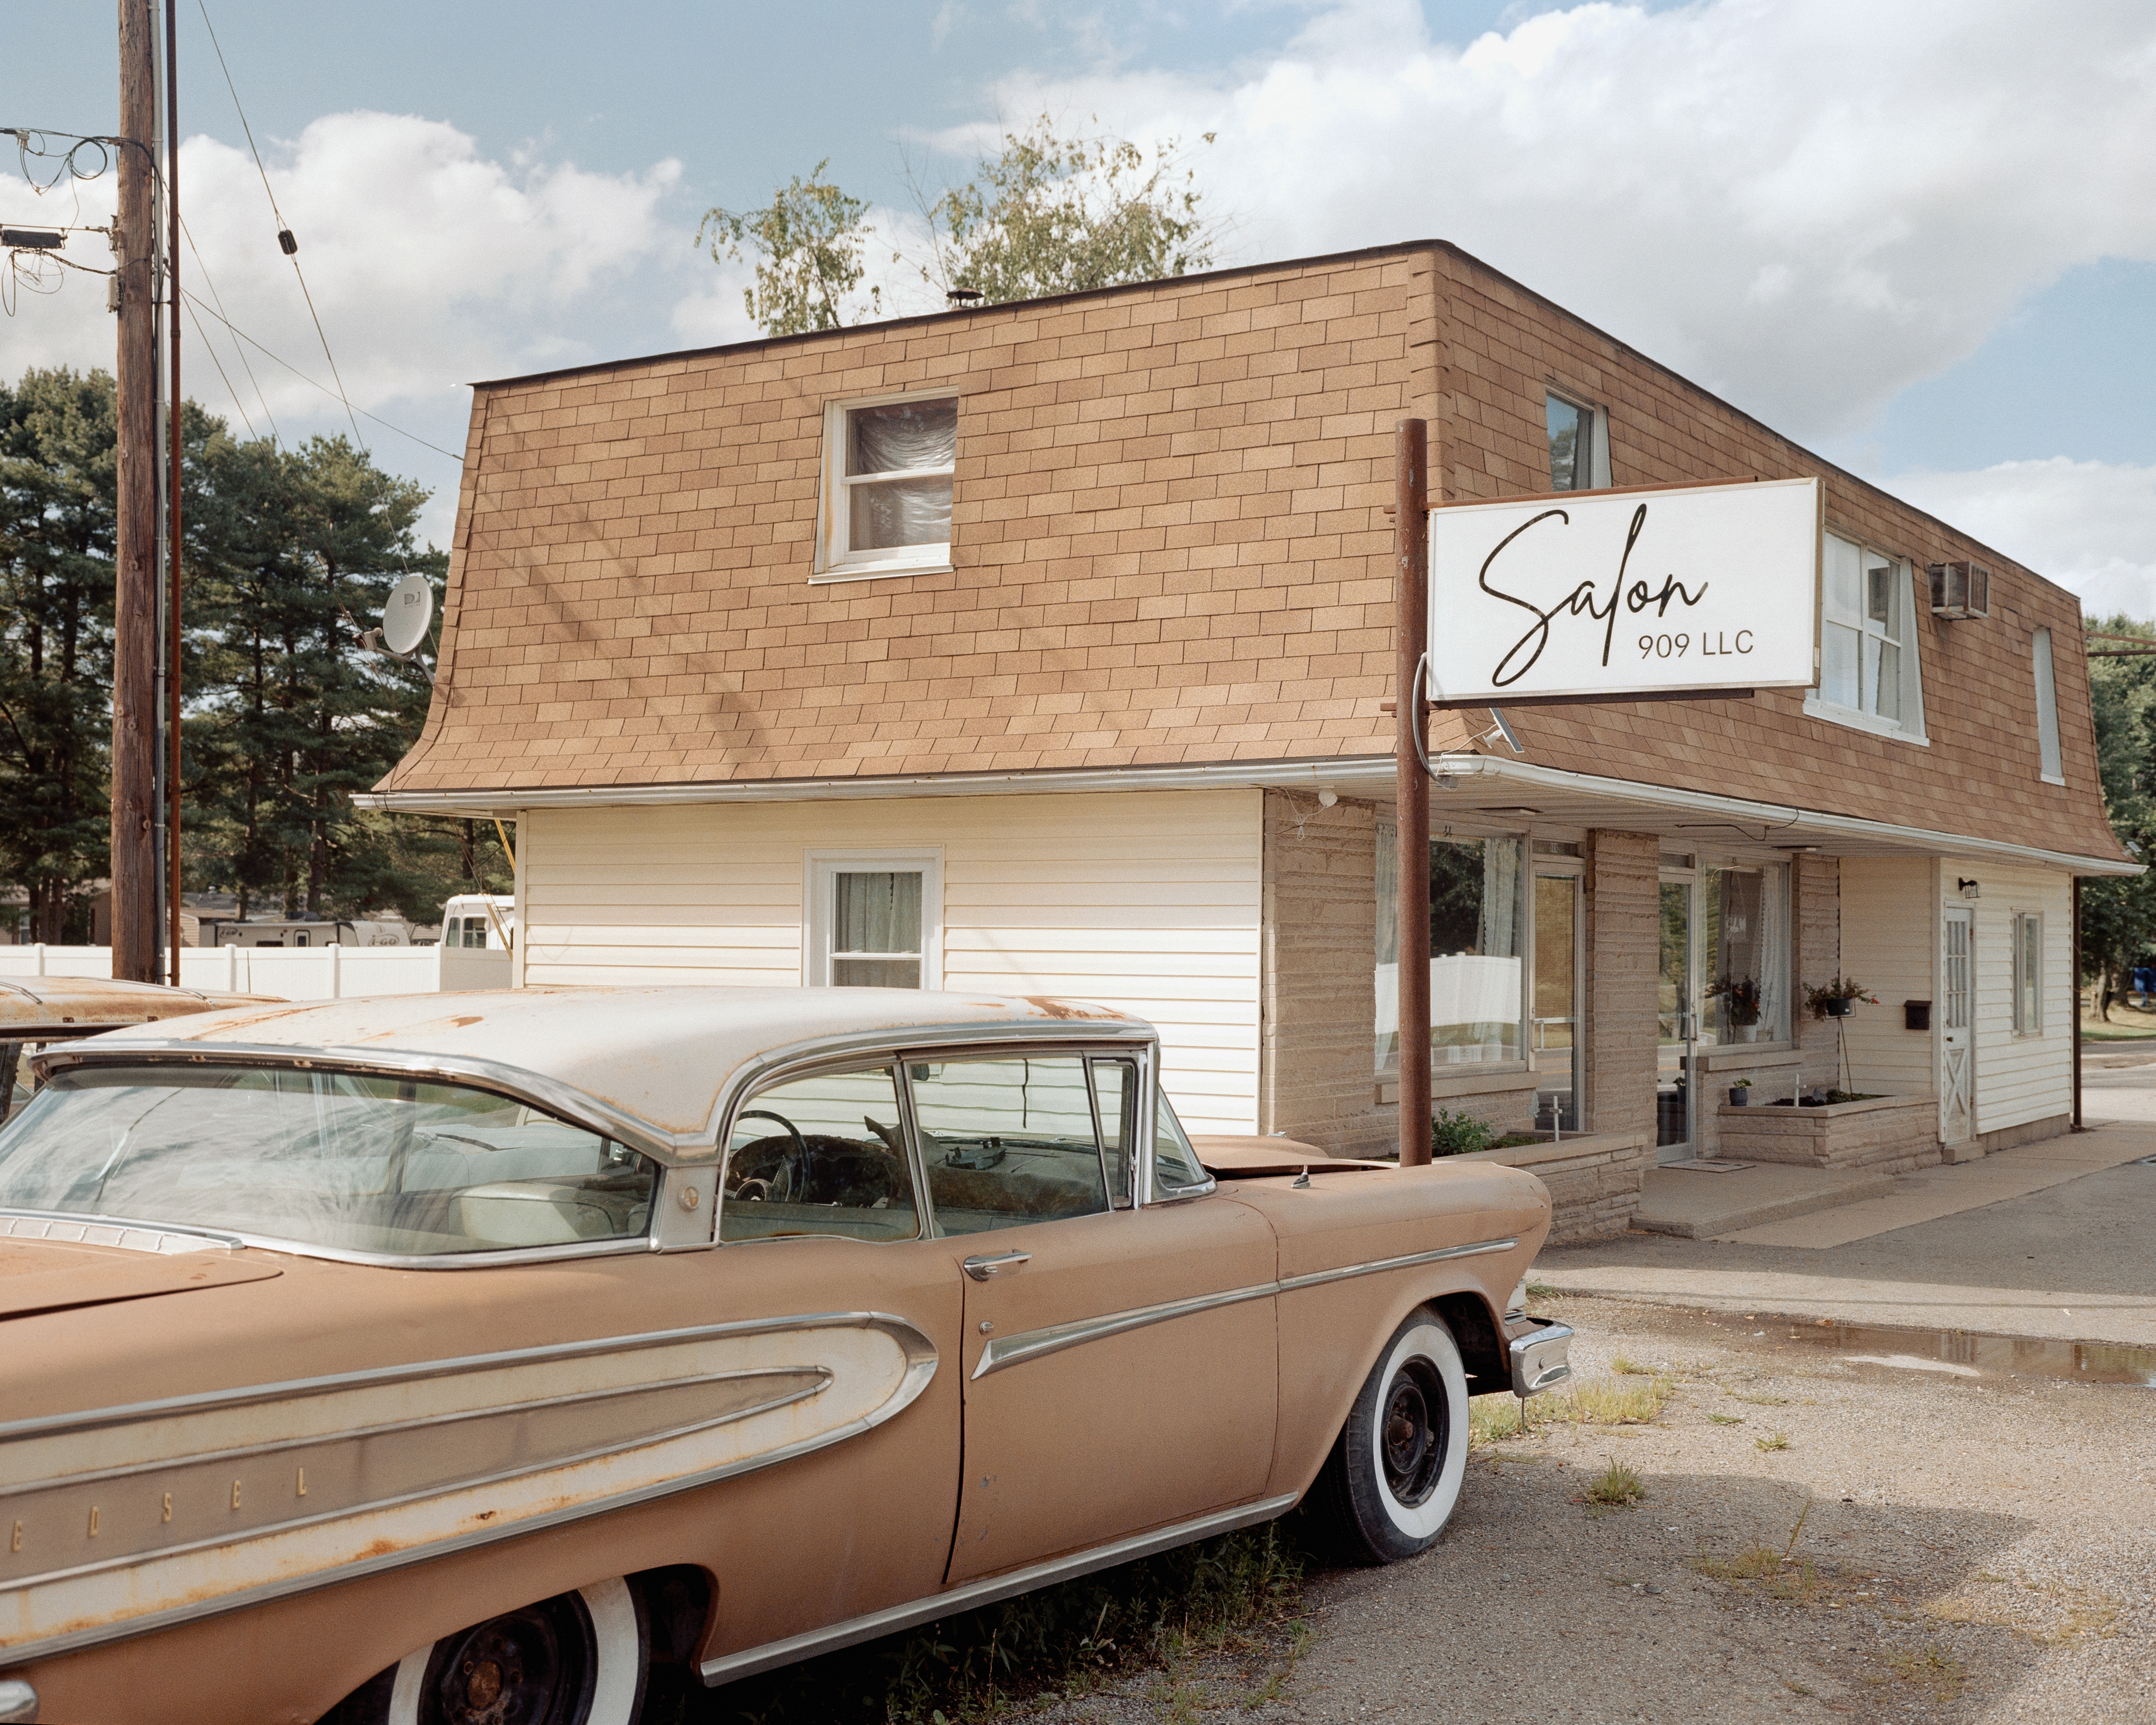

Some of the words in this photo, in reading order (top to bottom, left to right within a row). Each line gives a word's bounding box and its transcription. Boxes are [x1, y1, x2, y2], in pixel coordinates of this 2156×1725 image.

[1479, 504, 1708, 686] Salon
[1638, 633, 1689, 659] 909
[1703, 630, 1753, 655] LLC
[12, 1467, 307, 1553] EDSEL
